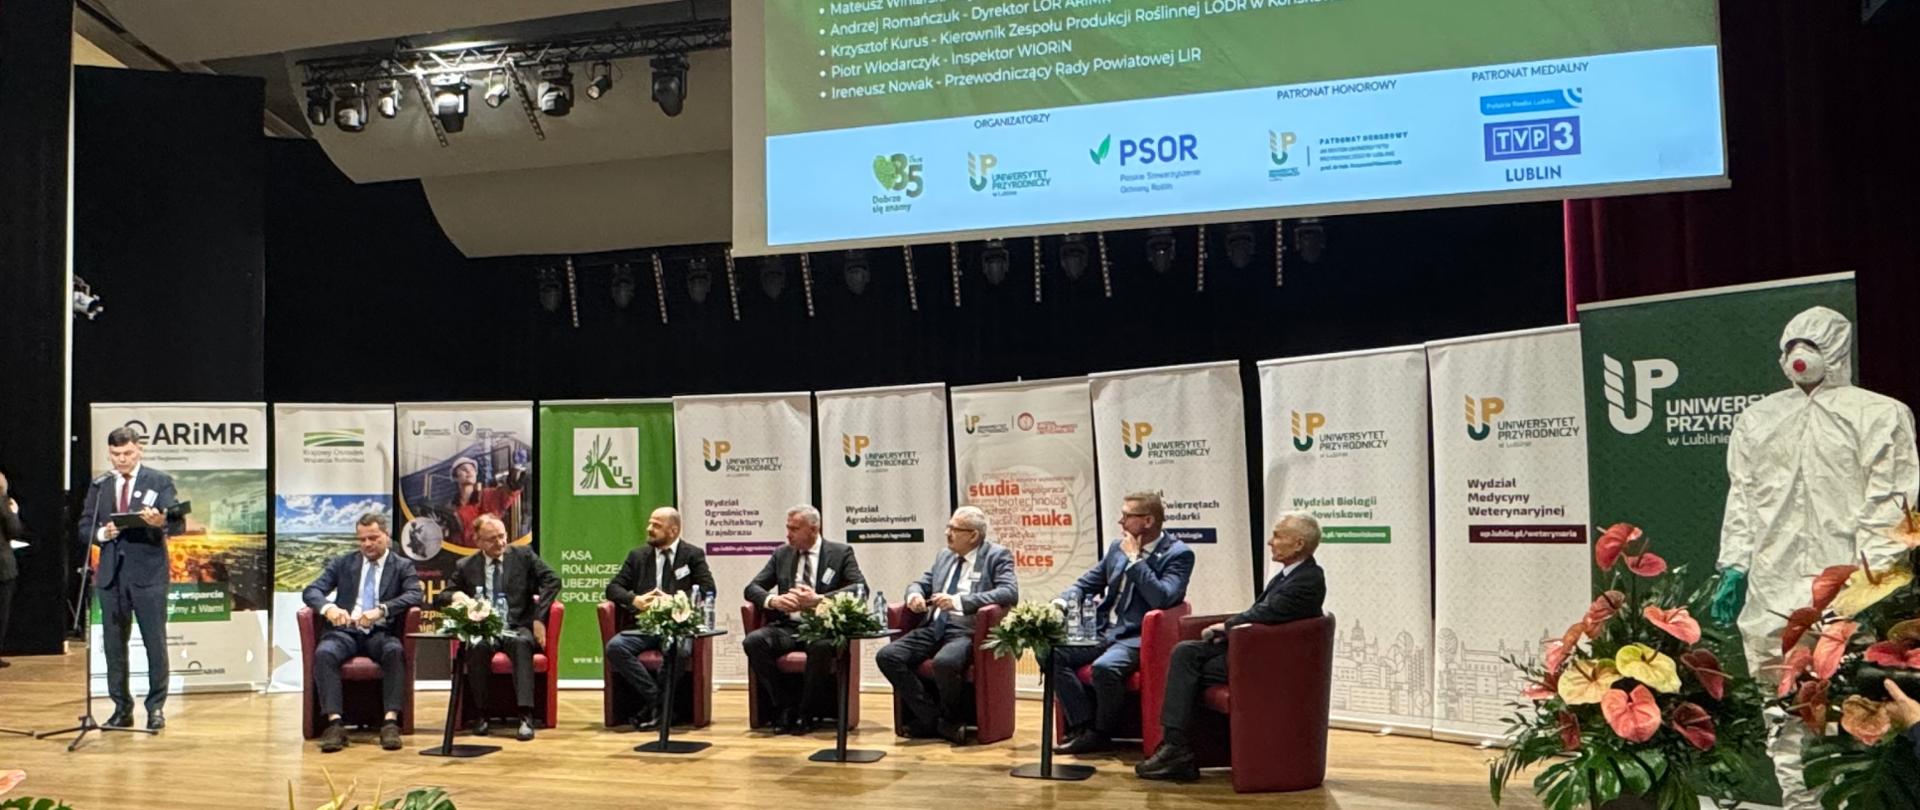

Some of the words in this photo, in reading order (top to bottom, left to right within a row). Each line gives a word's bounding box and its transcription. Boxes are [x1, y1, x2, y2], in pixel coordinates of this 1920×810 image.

[830, 0, 883, 15] Mateusz
[830, 18, 880, 37] Andrzej
[882, 9, 960, 30] Romańczuk
[971, 3, 1030, 20] Dyrektor
[1033, 0, 1062, 12] LOR
[831, 38, 889, 57] Krzysztof
[891, 36, 929, 50] Kurus
[940, 25, 1006, 44] Kierownik
[1008, 19, 1063, 38] Zespołu
[1066, 10, 1132, 30] Produkcji
[1135, 3, 1201, 22] Roślinnej
[1204, 0, 1247, 15] LODR
[831, 62, 862, 78] Piotr
[864, 55, 941, 75] Włodarczyk
[951, 48, 1014, 65] Inspektor
[1017, 40, 1072, 57] WIORiN
[832, 84, 886, 99] Ireneusz
[888, 77, 934, 93] Nowak
[944, 65, 1052, 87] Przewodniczący
[1055, 58, 1090, 76] Rady
[1092, 50, 1175, 72] Powiatowej
[1178, 47, 1202, 63] LIR
[1471, 67, 1528, 82] PATRONAT
[1531, 62, 1589, 77] MEDIALNY
[1277, 86, 1329, 100] PATRONAT
[1332, 79, 1397, 95] HONOROWY
[974, 113, 1051, 129] ORGANIZATORZY
[1119, 133, 1199, 167] PSOR
[1505, 165, 1562, 183] LUBLIN
[1497, 416, 1576, 430] UNIWERSYTET
[151, 422, 249, 446] ARiMR
[1319, 430, 1385, 441] UNIWERSYTET
[1498, 426, 1580, 440] PRZYRODNICZY
[1667, 437, 1680, 446] w
[1681, 433, 1731, 446] Lublinie
[1147, 440, 1207, 450] UNIWERSYTET
[1319, 440, 1388, 450] PRZYRODNICZY
[1147, 448, 1211, 458] PRZYRODNICZY
[968, 479, 1020, 497] studia
[1467, 478, 1517, 490] Wydział
[704, 499, 739, 507] Wydział
[1292, 497, 1335, 508] Wydział
[1337, 496, 1377, 507] Biologii
[1468, 493, 1530, 504] Medycyny
[845, 505, 879, 514] Wydział
[1468, 505, 1565, 518] Weterynaryjnej
[709, 519, 764, 527] Architektury
[1021, 509, 1073, 526] nauka
[561, 550, 593, 560] KASA
[1015, 550, 1054, 567] kces
[561, 578, 611, 588] UBEZPIE
[561, 591, 607, 602] SPOŁEC
